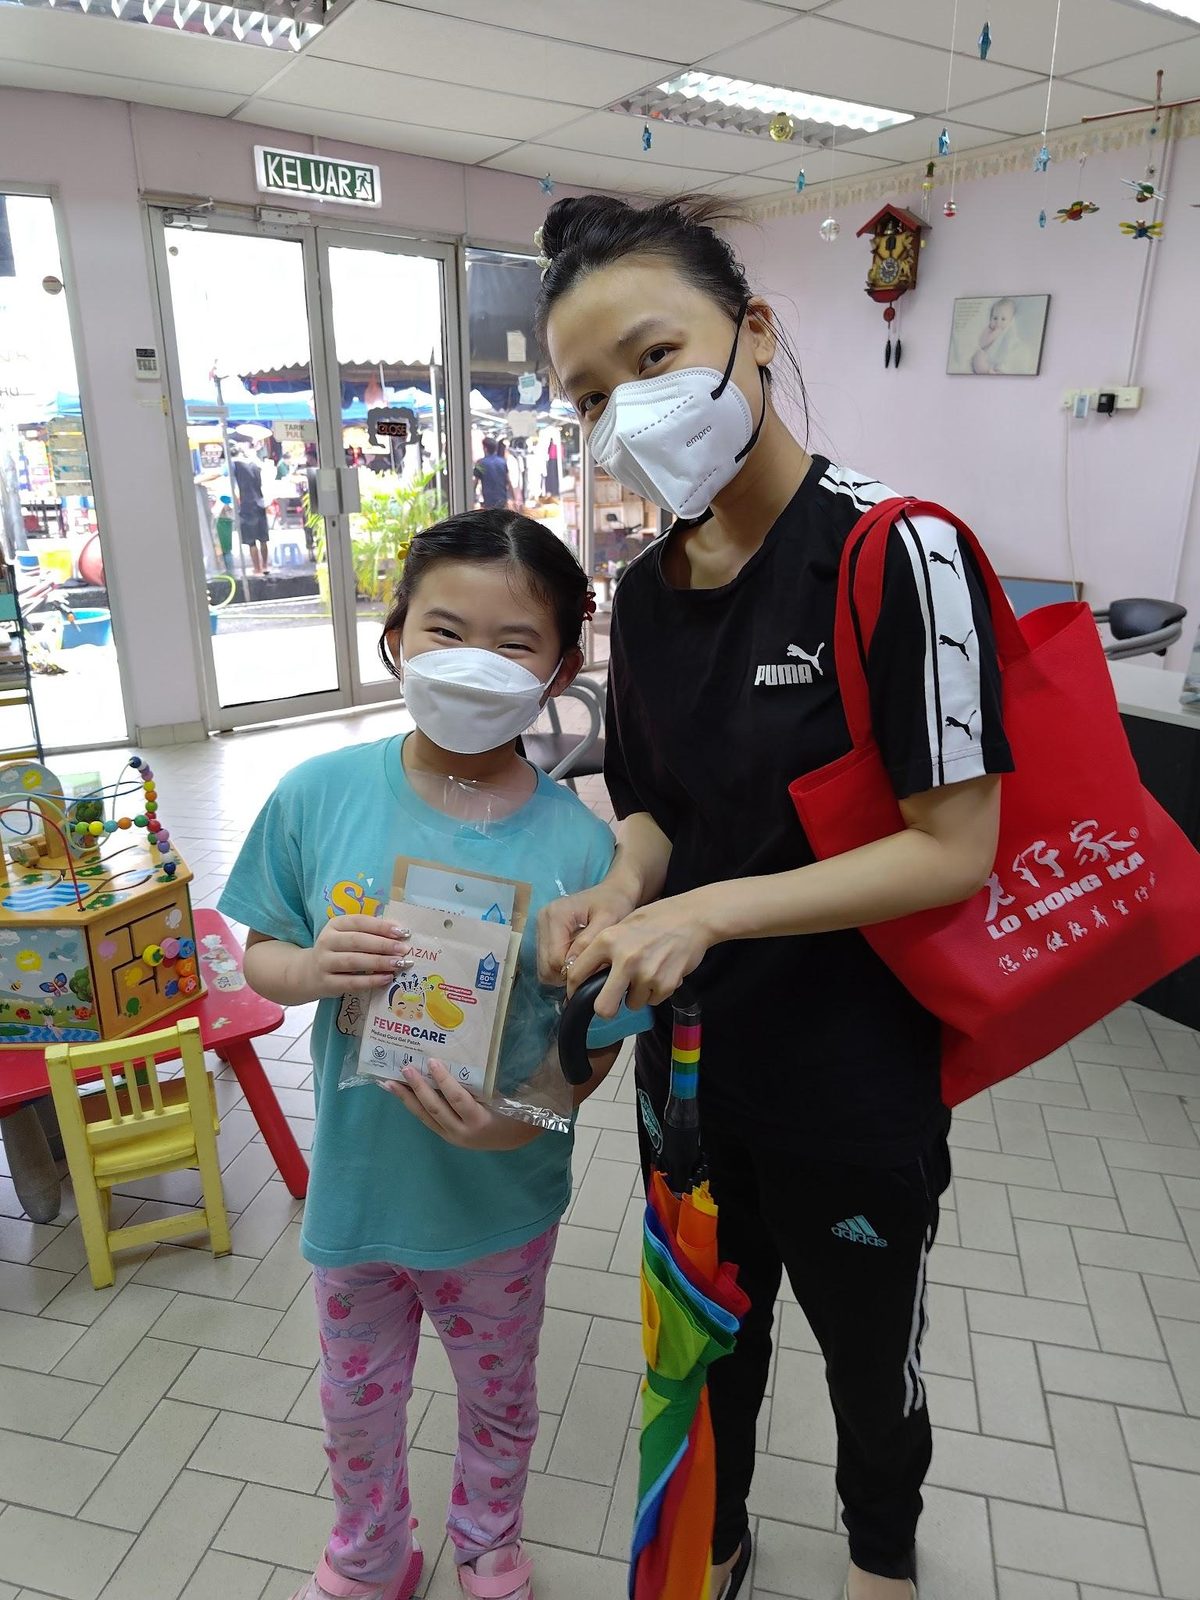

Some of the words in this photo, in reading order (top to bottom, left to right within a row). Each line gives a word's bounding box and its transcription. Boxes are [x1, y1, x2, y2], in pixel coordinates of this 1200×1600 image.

[267, 154, 352, 197] KELUAR
[284, 423, 305, 431] TARIK
[286, 430, 305, 439] PULL
[378, 423, 407, 436] CLOSE
[685, 425, 712, 448] empro
[754, 663, 813, 686] PUMA
[987, 913, 1022, 940] LO
[1024, 873, 1103, 922] HONG
[1105, 851, 1146, 881] KA
[373, 1015, 447, 1045] FEVERCARE
[830, 1226, 888, 1248] adidas
